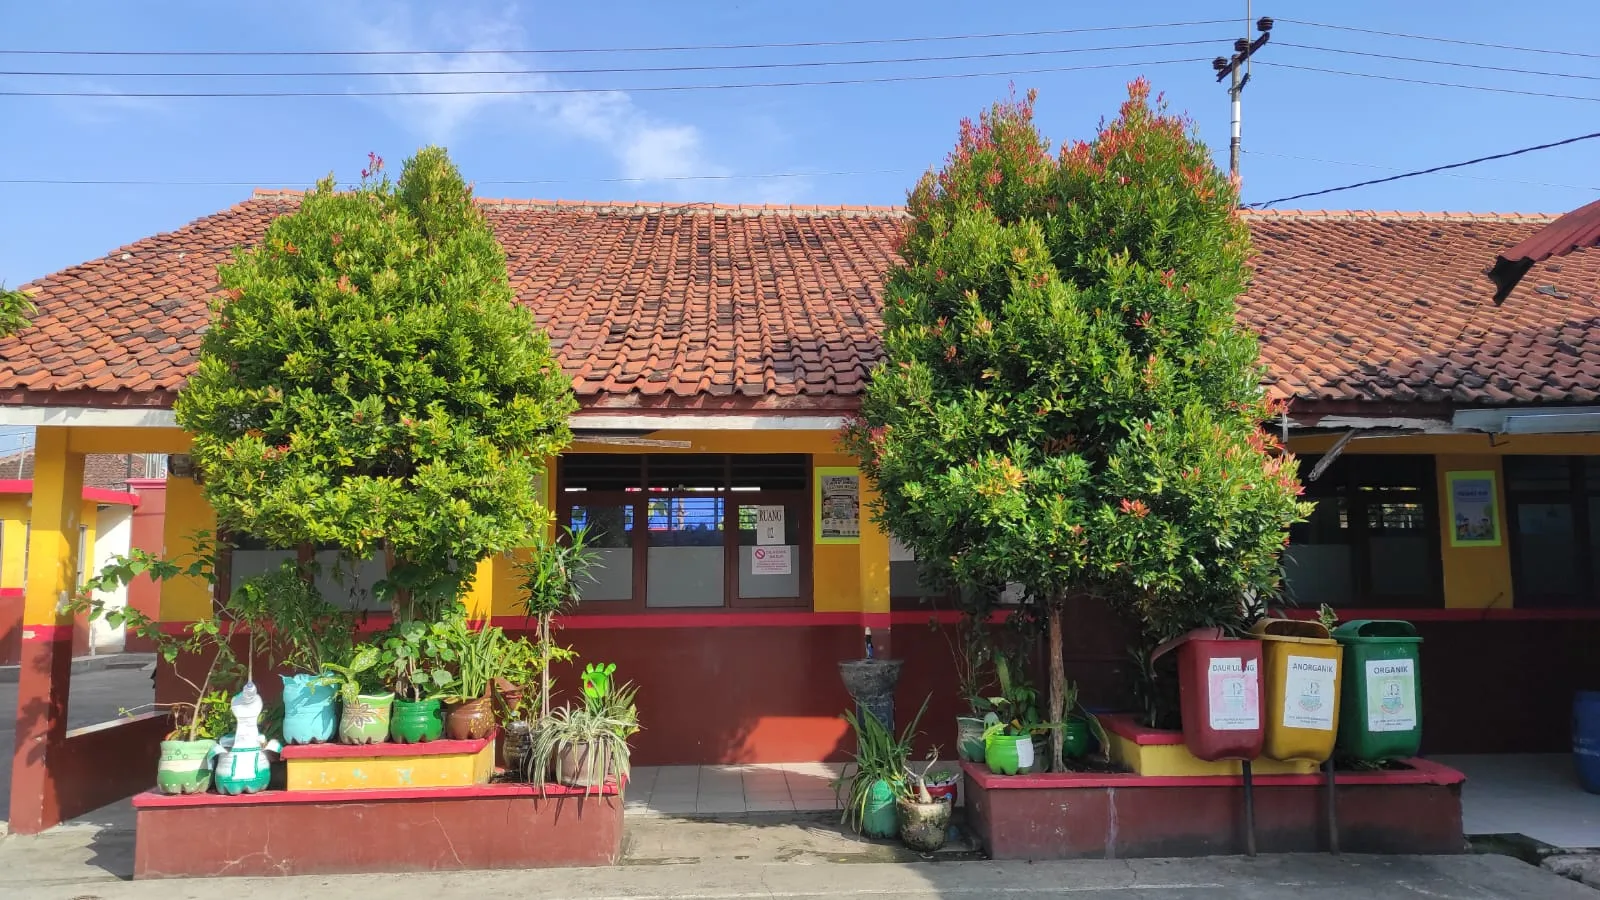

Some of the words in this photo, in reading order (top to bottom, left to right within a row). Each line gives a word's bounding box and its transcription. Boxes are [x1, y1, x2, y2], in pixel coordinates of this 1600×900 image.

[759, 510, 782, 521] RUANG
[1212, 664, 1231, 672] DAUR
[1232, 664, 1255, 672] ULNG
[1292, 663, 1333, 673] ANORGANIK
[1373, 665, 1408, 674] ORGANIK
